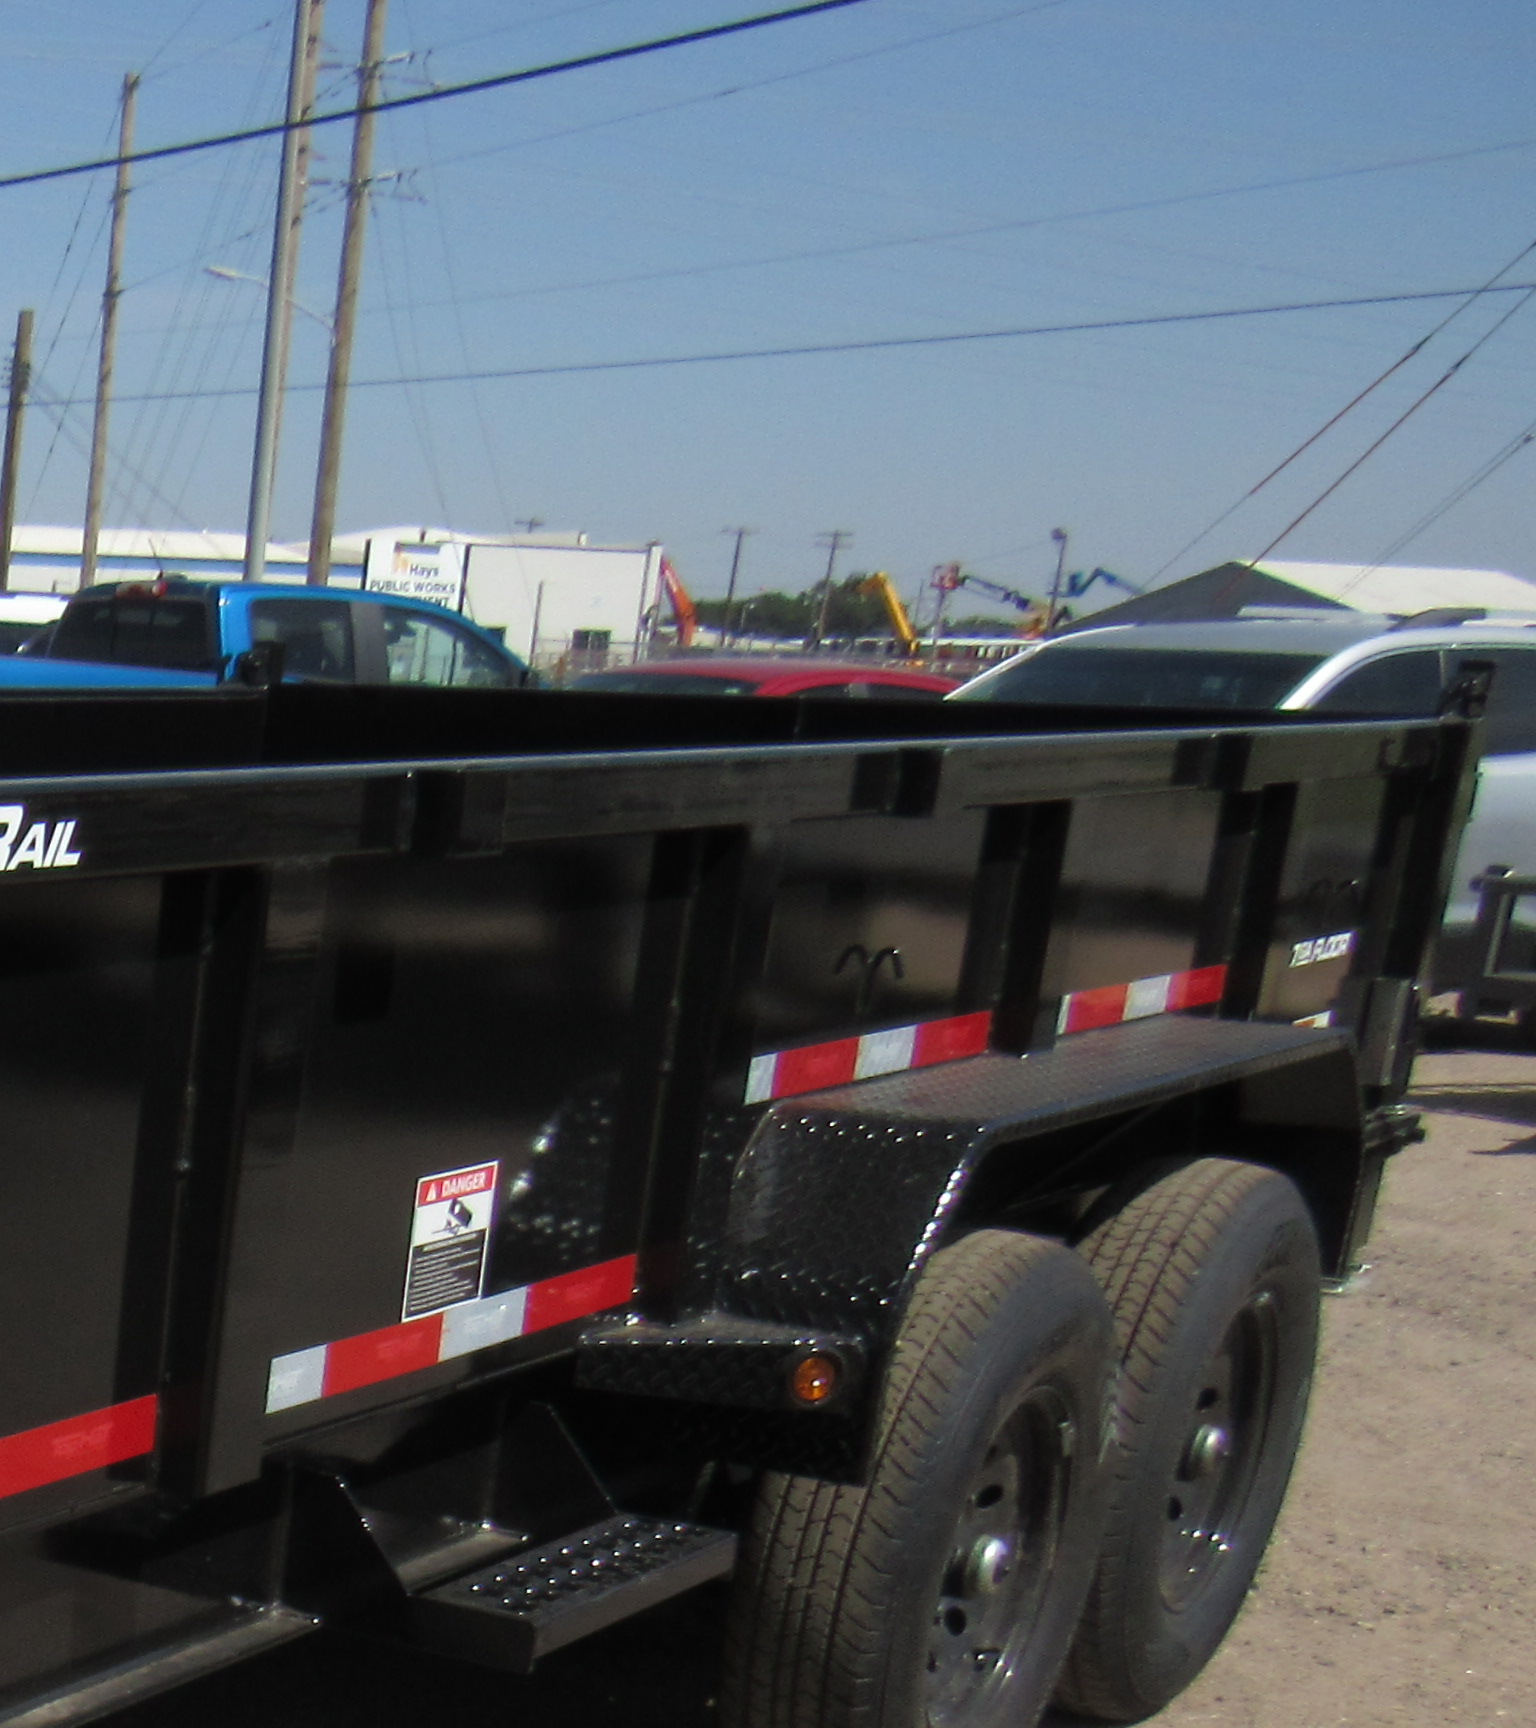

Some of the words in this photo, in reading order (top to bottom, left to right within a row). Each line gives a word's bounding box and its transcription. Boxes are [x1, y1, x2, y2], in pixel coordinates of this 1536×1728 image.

[410, 563, 439, 579] Hays
[370, 580, 411, 593] PUBLIC
[413, 582, 456, 594] WORKS
[441, 1171, 487, 1198] DANGER
